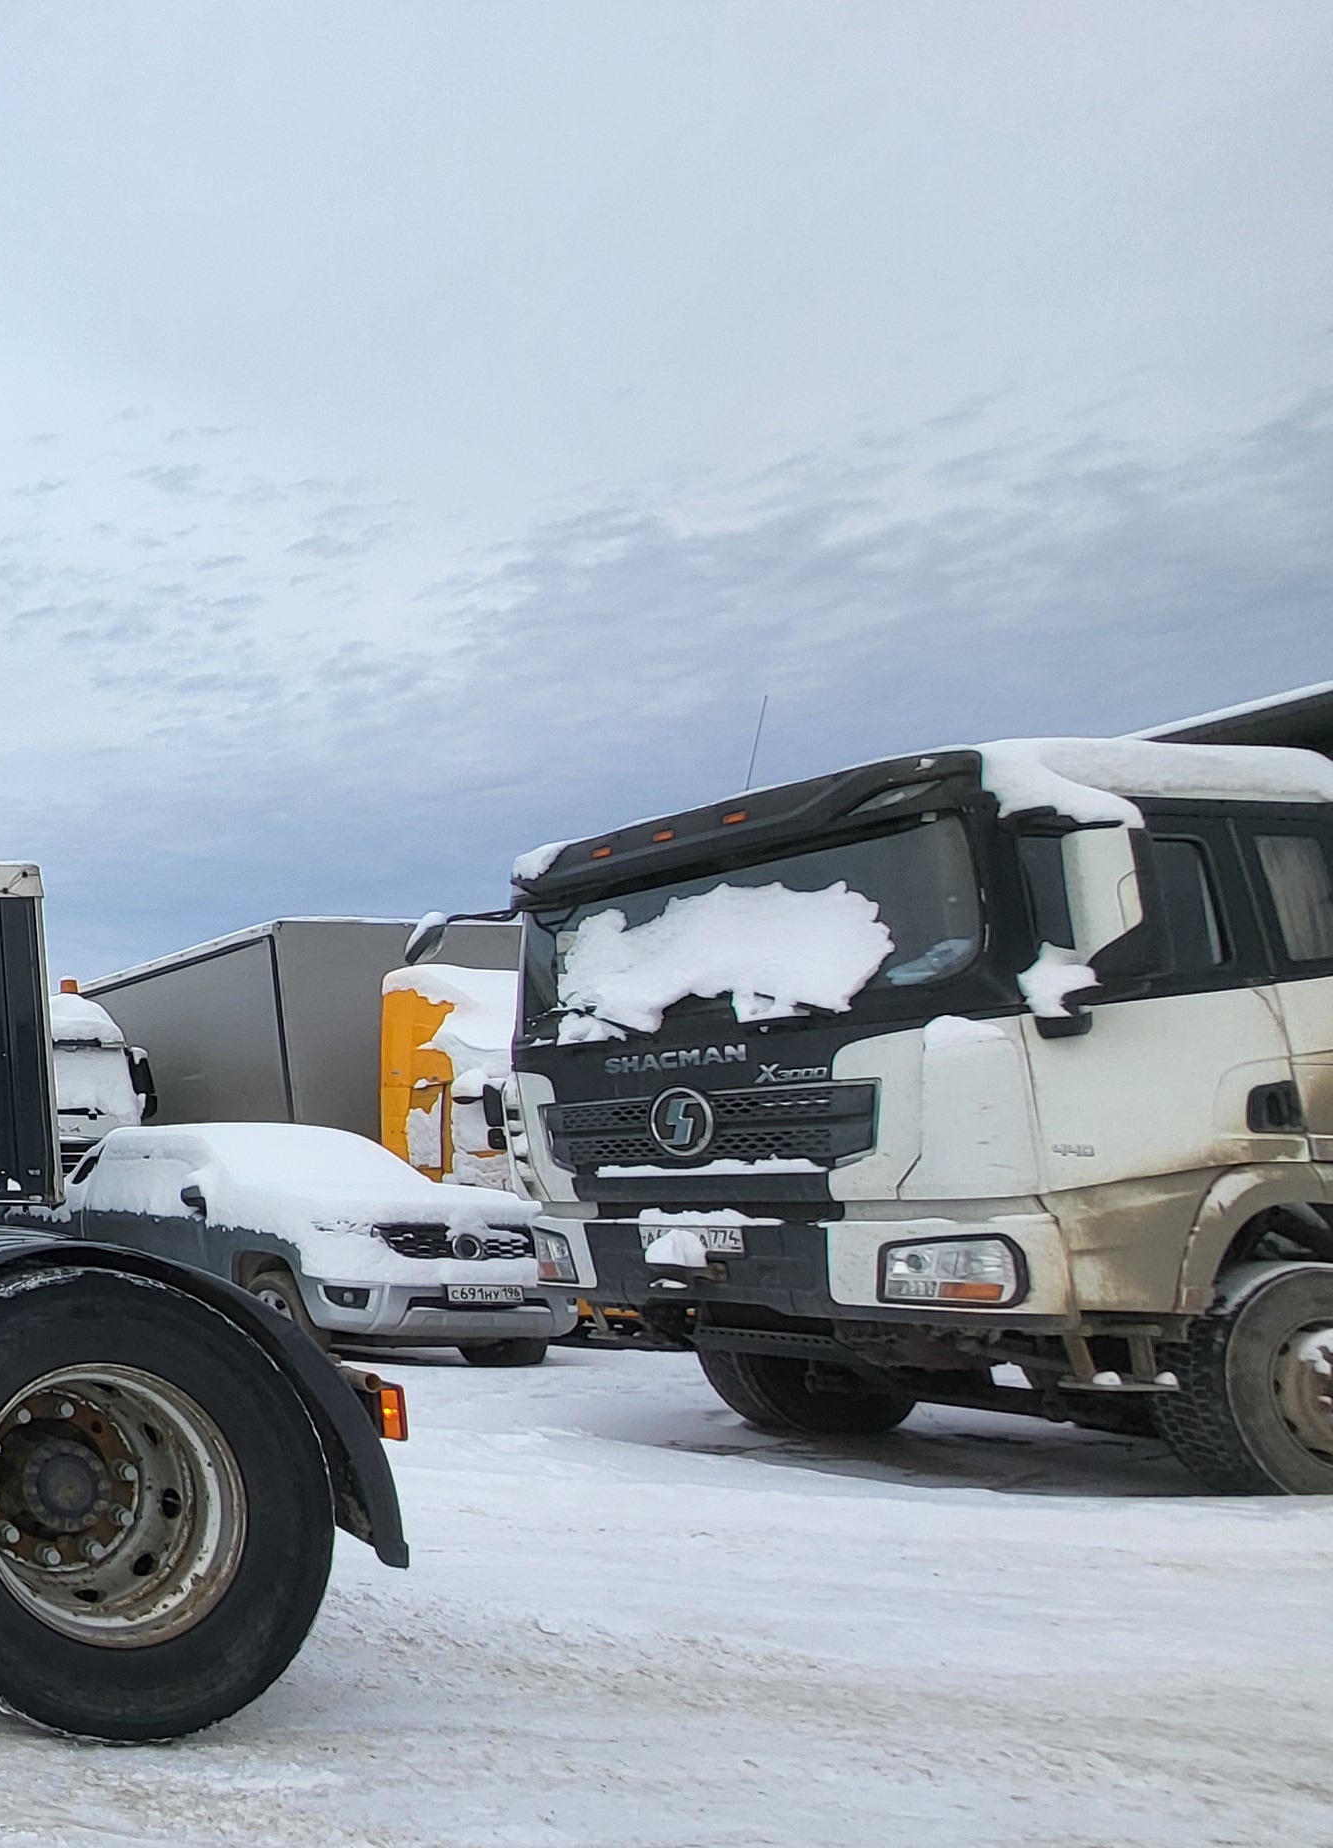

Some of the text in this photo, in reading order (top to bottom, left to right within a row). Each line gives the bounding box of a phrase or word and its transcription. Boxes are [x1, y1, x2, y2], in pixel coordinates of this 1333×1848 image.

[604, 1044, 747, 1074] SHACMAN
[754, 1063, 828, 1083] X3000
[710, 1229, 740, 1245] 774
